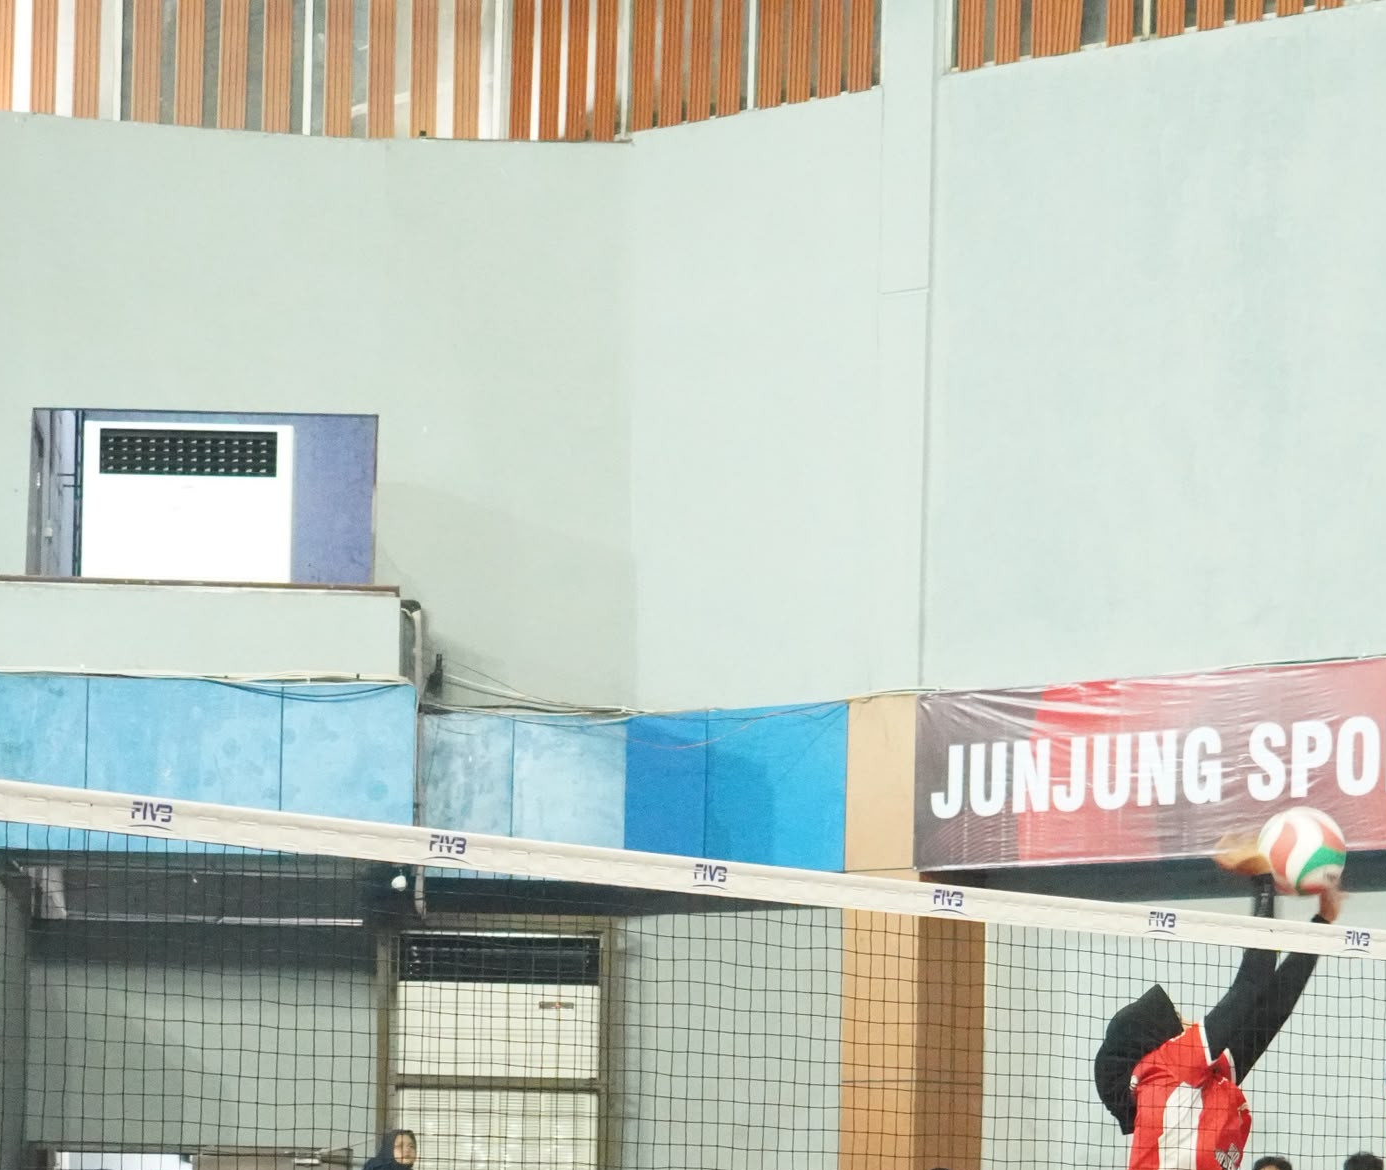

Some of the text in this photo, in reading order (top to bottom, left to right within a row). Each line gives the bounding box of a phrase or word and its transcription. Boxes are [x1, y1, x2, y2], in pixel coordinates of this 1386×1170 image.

[930, 726, 1221, 820] JUNJUNG
[131, 801, 173, 823] FIVB
[429, 833, 467, 855] FIVB
[693, 863, 728, 883] FIVB
[933, 888, 964, 908] FIVB
[1149, 911, 1176, 928] FIVB
[1345, 930, 1370, 947] FIVB
